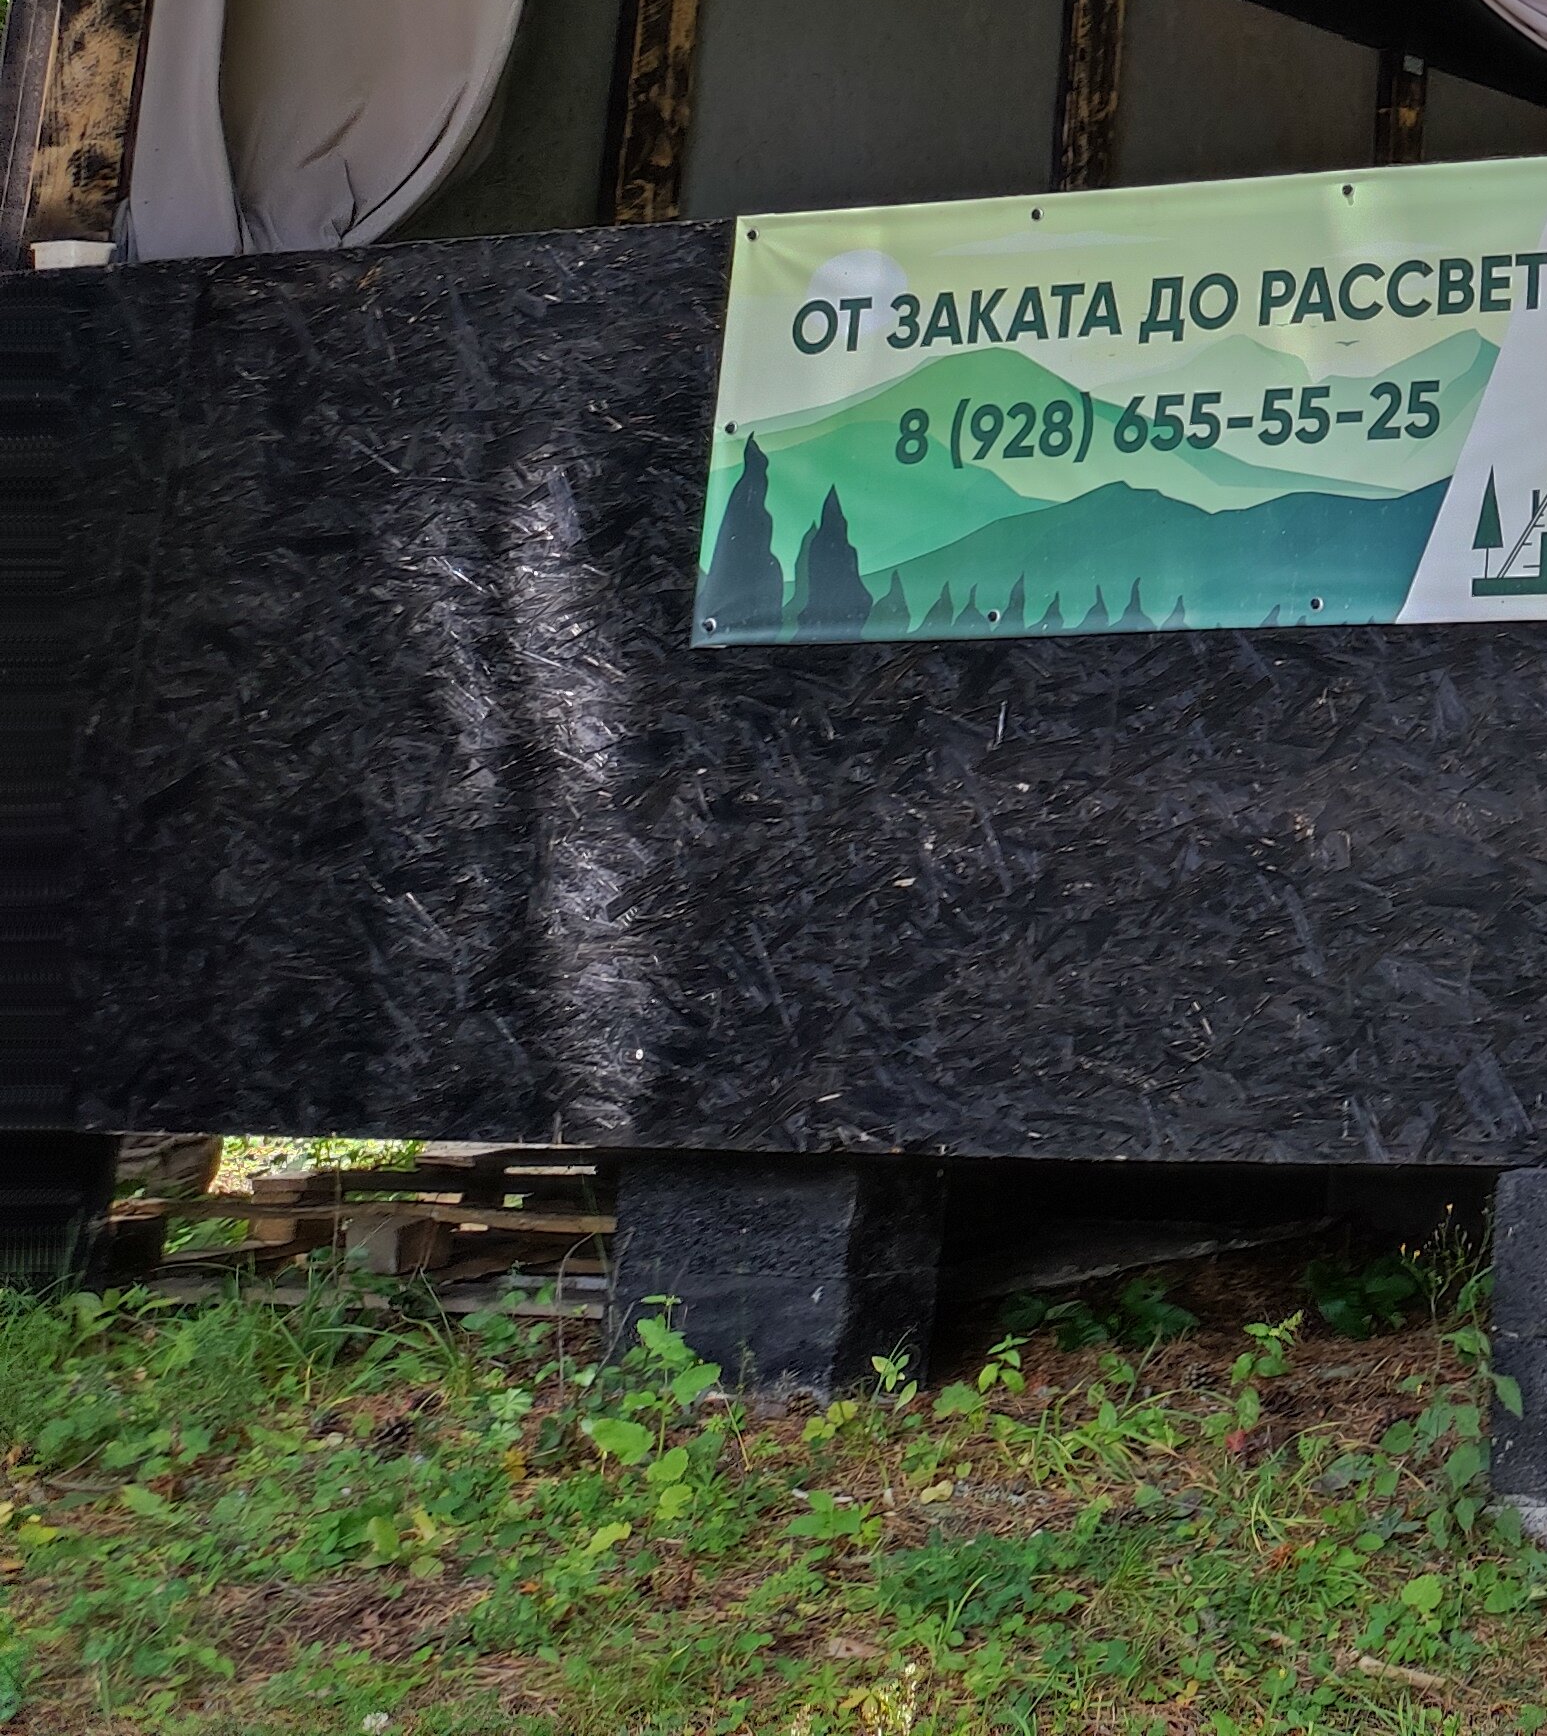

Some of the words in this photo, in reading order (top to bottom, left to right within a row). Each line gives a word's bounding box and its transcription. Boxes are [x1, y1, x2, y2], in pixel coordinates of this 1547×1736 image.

[791, 297, 873, 355] ОТ
[886, 280, 1122, 350] ЗАКАТА
[1139, 273, 1239, 345] ДО
[894, 408, 929, 465] 8
[950, 392, 1095, 470] (928)
[1113, 380, 1442, 454] 655-55-25
